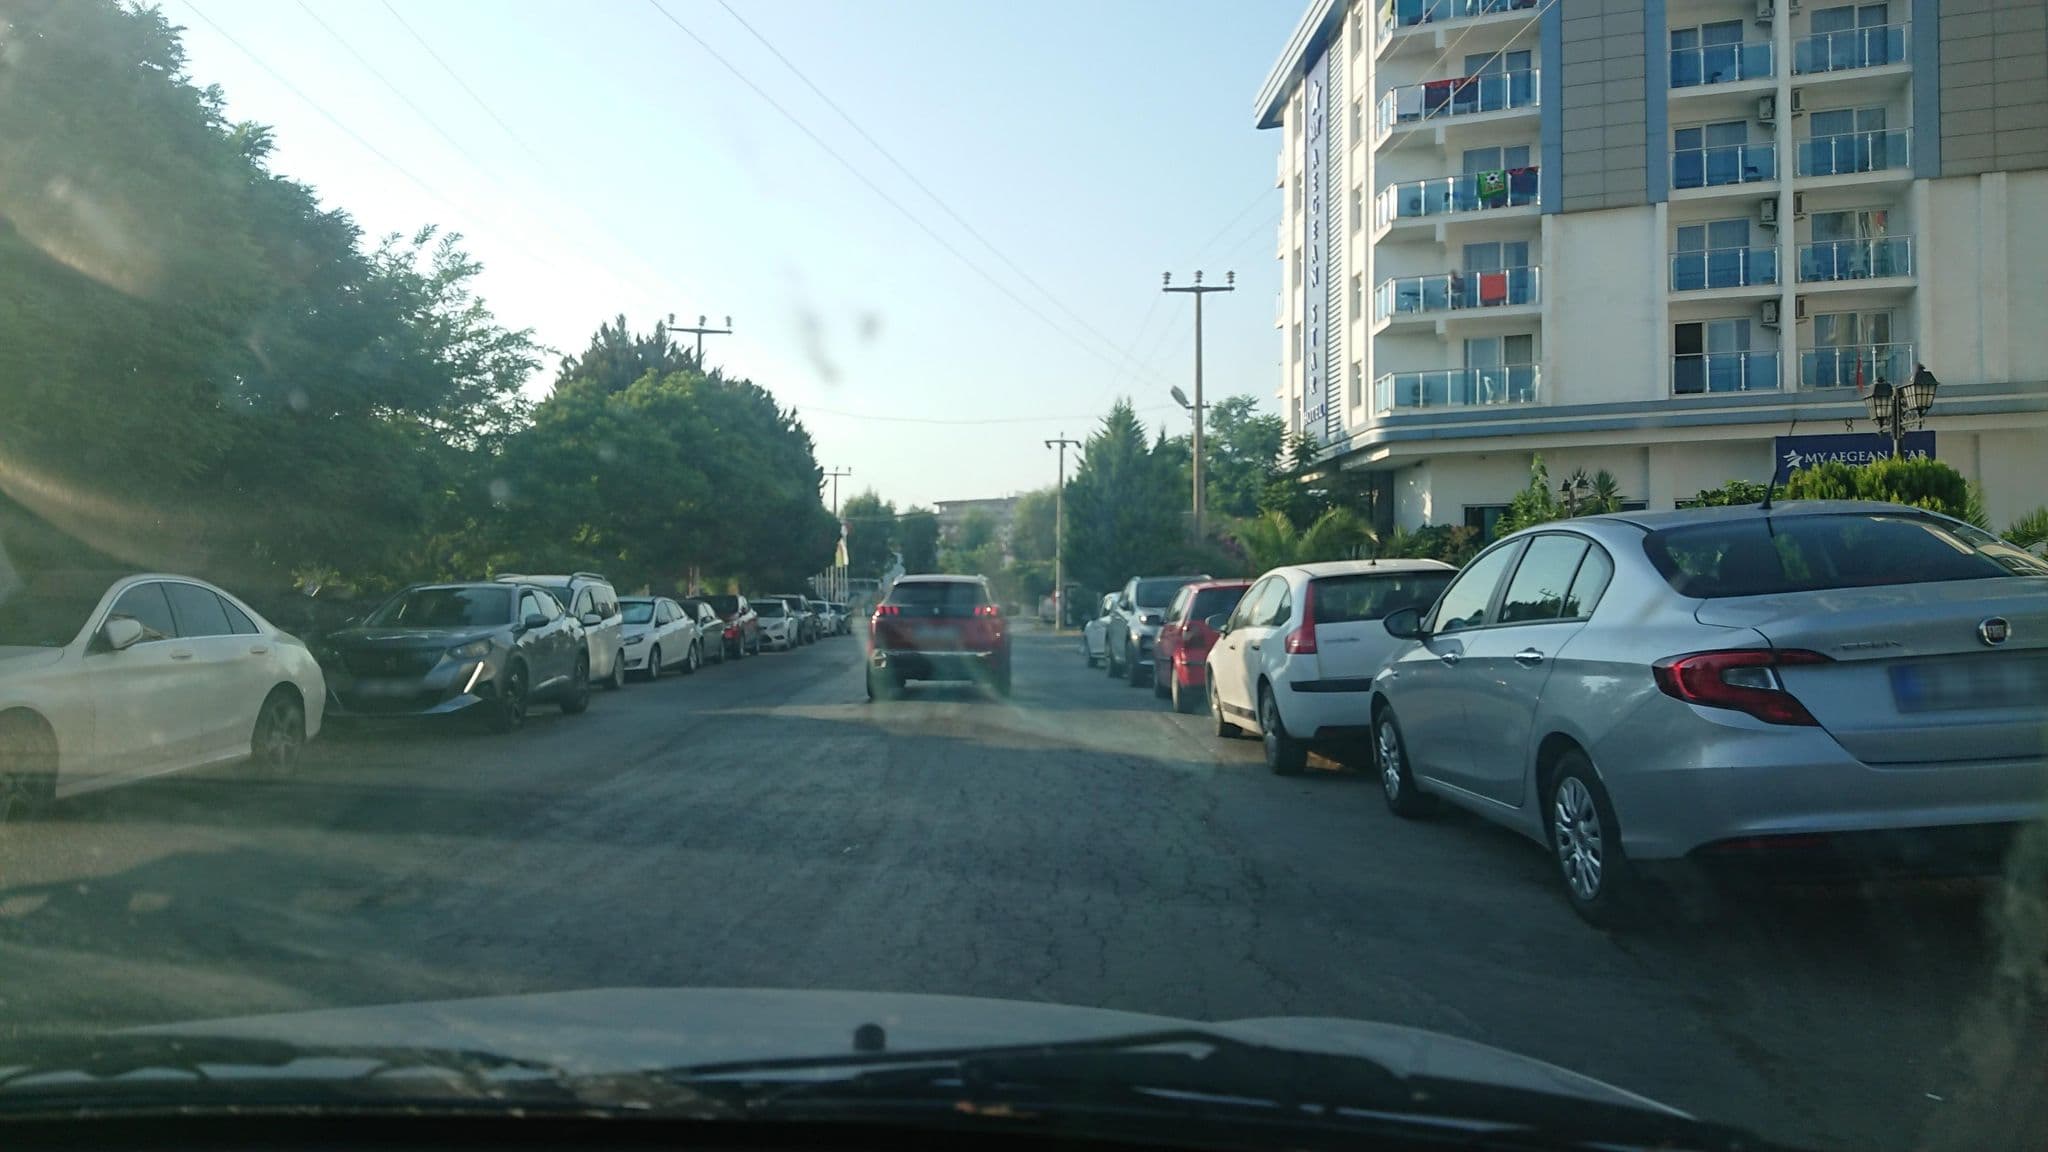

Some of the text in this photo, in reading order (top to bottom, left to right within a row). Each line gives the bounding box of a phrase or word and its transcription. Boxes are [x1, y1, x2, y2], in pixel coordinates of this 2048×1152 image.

[1310, 148, 1321, 288] AEGEAN
[1309, 304, 1319, 395] STAR
[1303, 403, 1326, 426] HOTEL
[1804, 452, 1827, 463] MY
[1829, 449, 1889, 462] AEGEAN
